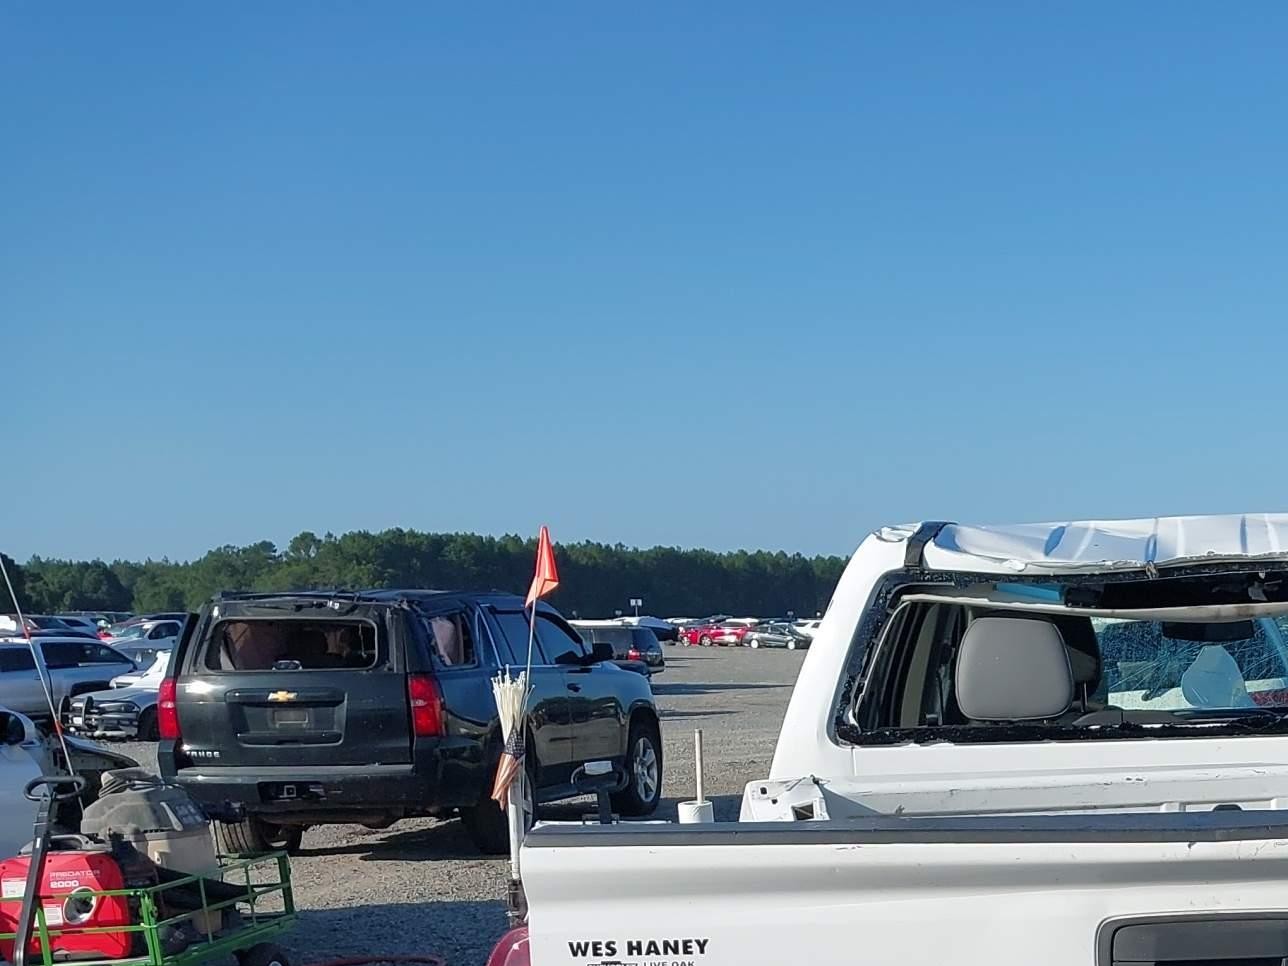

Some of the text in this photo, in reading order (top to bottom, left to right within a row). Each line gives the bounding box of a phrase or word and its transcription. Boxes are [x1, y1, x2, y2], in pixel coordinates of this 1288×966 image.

[50, 880, 79, 888] 2000
[568, 939, 709, 957] WES HANEY
